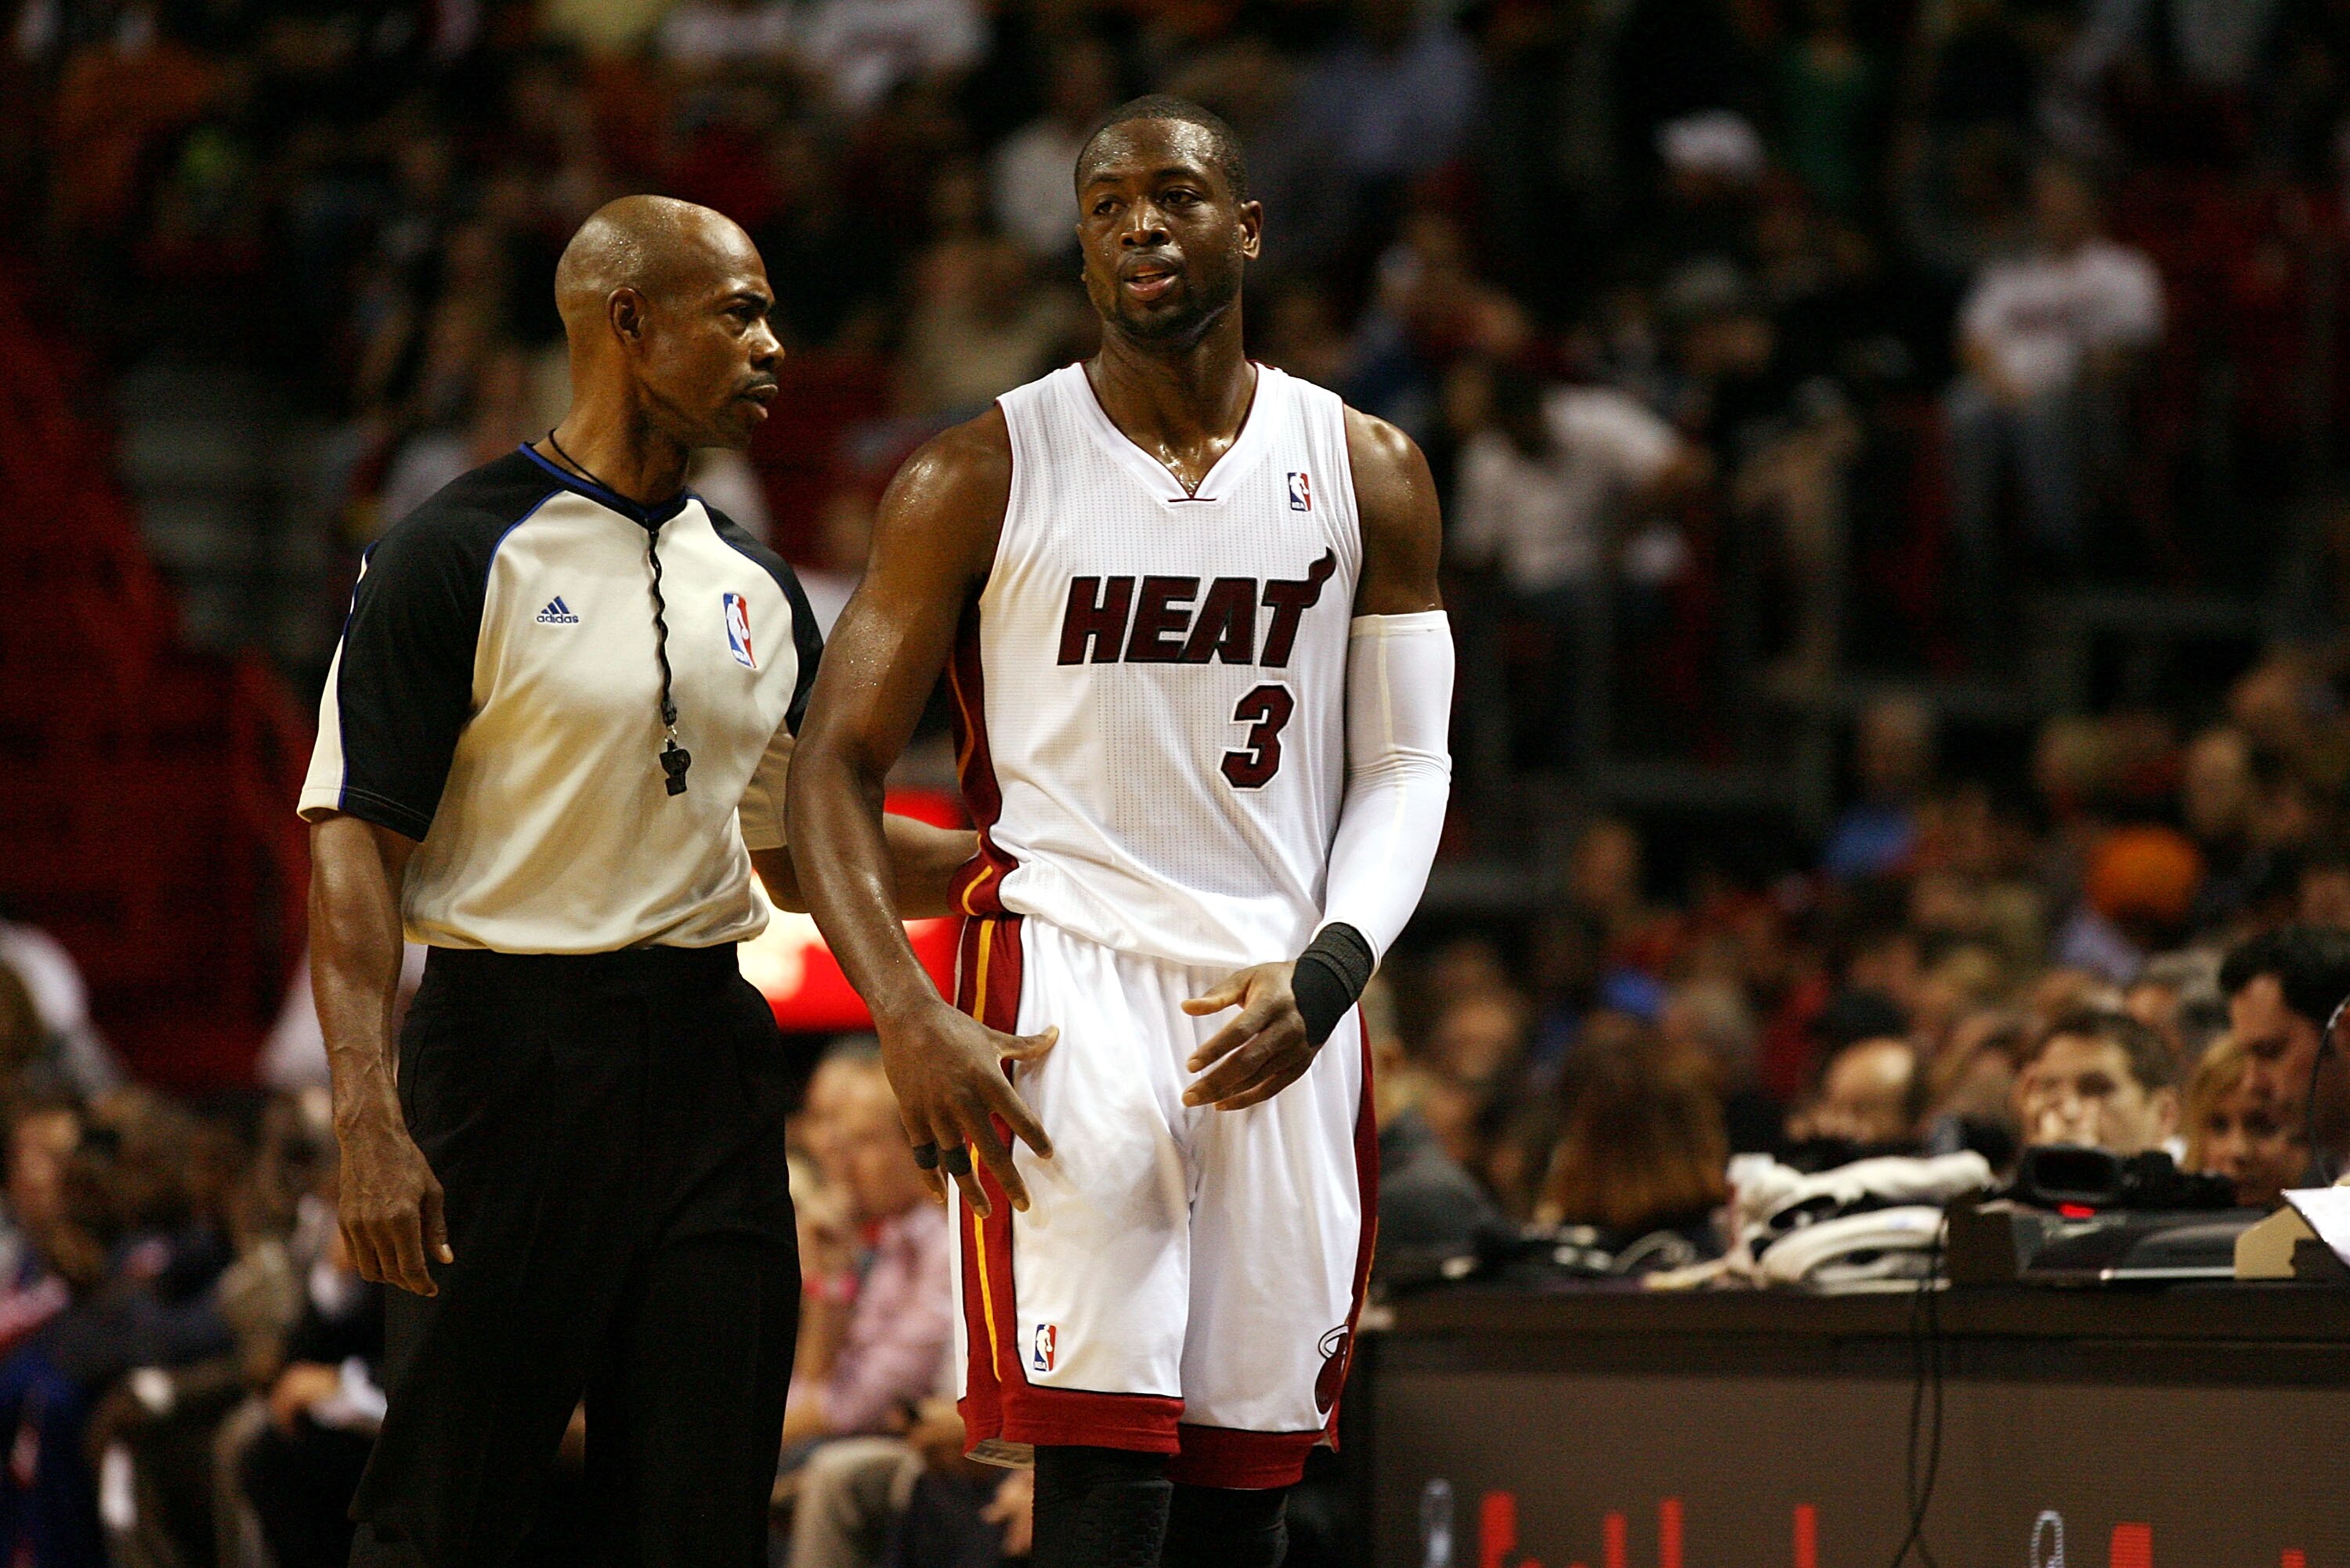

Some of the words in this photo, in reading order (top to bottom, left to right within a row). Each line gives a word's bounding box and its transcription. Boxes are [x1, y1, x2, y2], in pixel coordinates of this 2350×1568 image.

[537, 614, 579, 623] adidas
[1057, 547, 1336, 667] HEAT
[1220, 682, 1296, 789] 3
